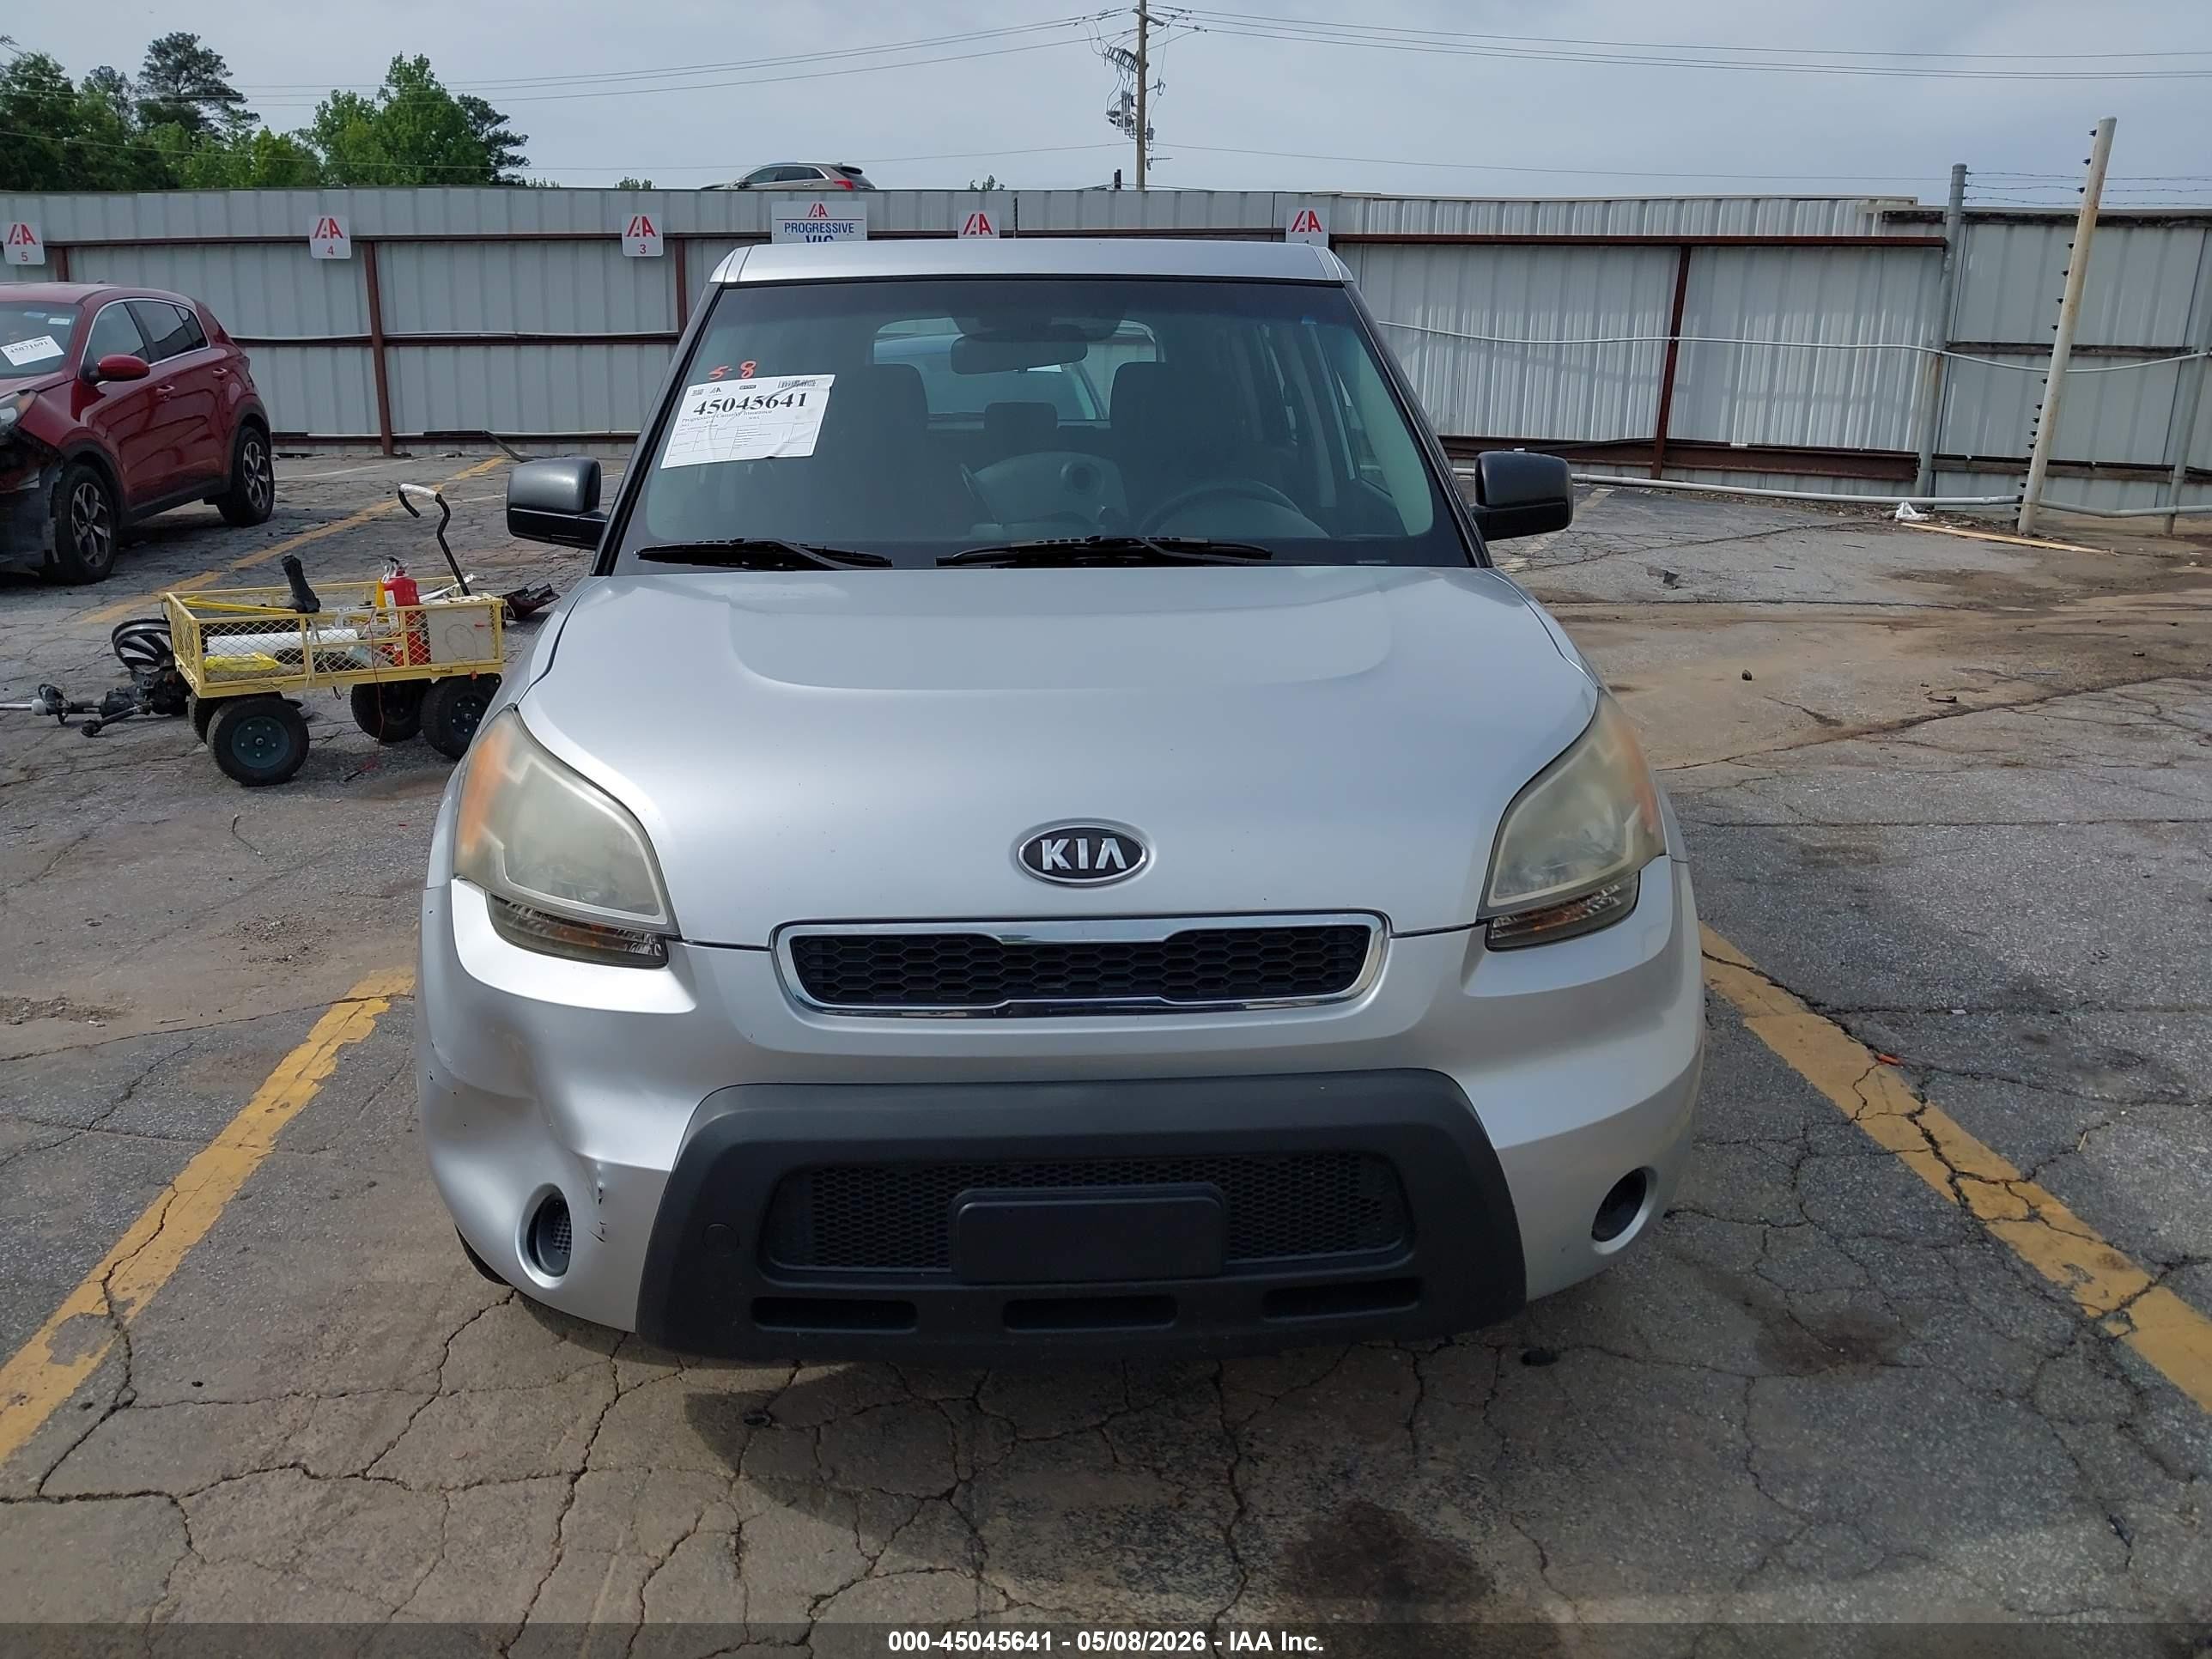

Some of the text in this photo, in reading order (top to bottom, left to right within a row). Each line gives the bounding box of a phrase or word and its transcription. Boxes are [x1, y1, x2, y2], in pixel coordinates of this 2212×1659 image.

[784, 222, 854, 234] PROGRESSIVE
[327, 246, 335, 256] 4
[639, 244, 647, 254] 3
[21, 252, 28, 262] 5
[693, 392, 808, 416] 45045641
[1040, 838, 1127, 871] KIA
